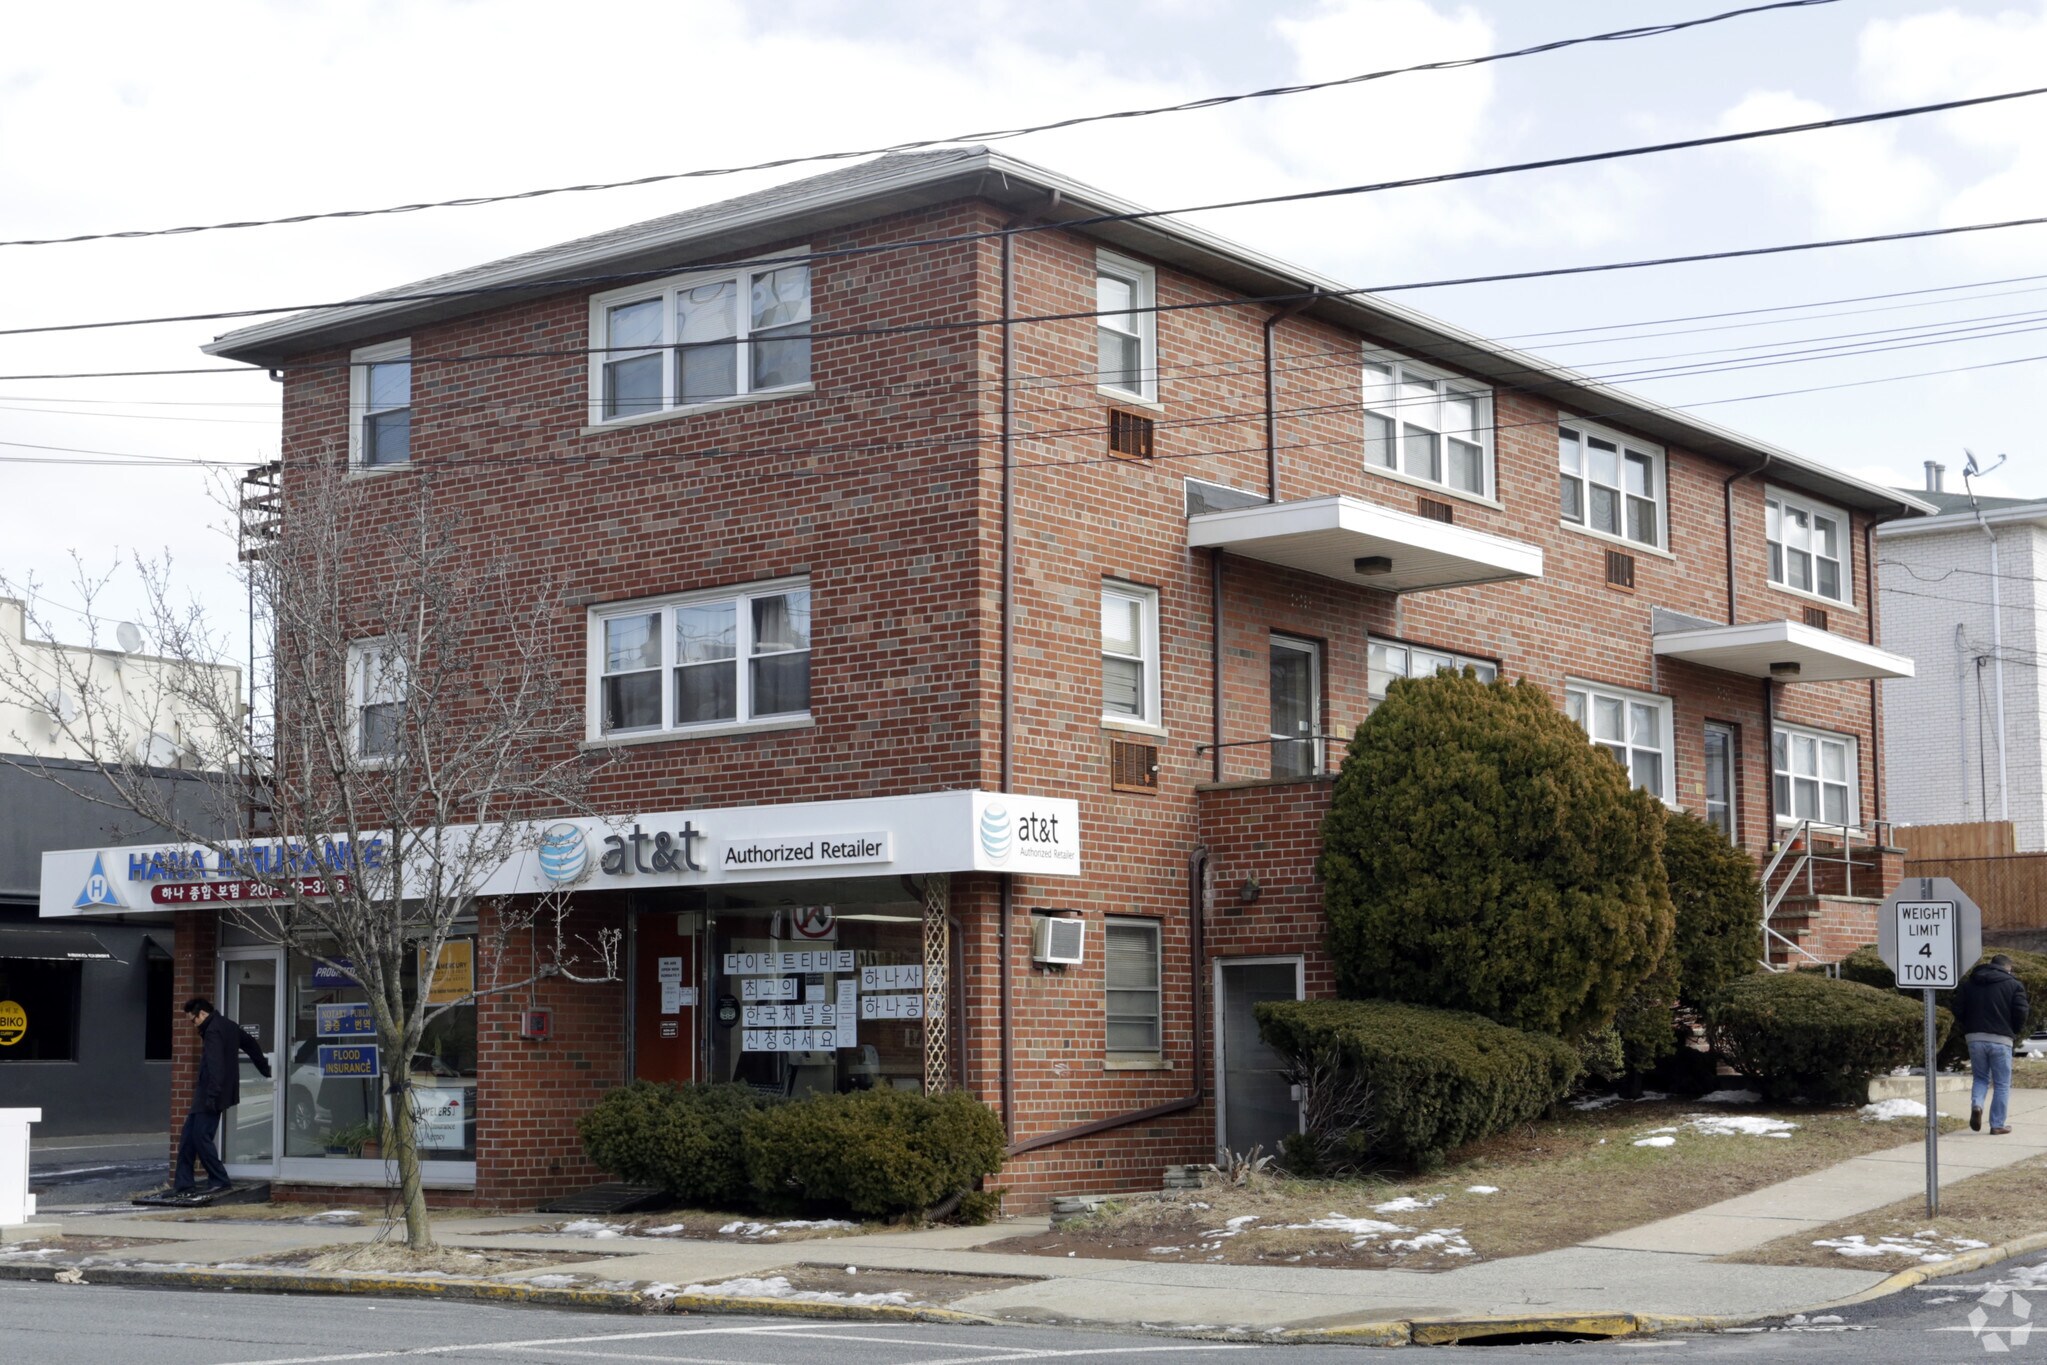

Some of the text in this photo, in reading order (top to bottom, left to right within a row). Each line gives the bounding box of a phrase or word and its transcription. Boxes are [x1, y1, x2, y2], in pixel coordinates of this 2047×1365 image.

[1018, 812, 1059, 844] at&t
[600, 821, 701, 876] at&t
[725, 838, 883, 865] Authorized Retailer
[1020, 847, 1075, 860] Authorized Retailer
[161, 886, 185, 900] 하나
[190, 885, 212, 901] 종합
[218, 883, 240, 899] 보험
[1902, 907, 1948, 920] WEIGHT
[1909, 924, 1940, 936] LIMIT
[1918, 942, 1932, 958] 4
[728, 951, 852, 973] 다이렉트티비로
[1904, 964, 1948, 981] TONS
[745, 979, 795, 999] 최고의
[321, 1009, 347, 1019] NOTARY
[746, 1004, 834, 1026] 한국채널을
[746, 1030, 834, 1051] 신청하세요
[333, 1050, 360, 1060] FLOOD
[325, 1063, 372, 1073] INSURANCE
